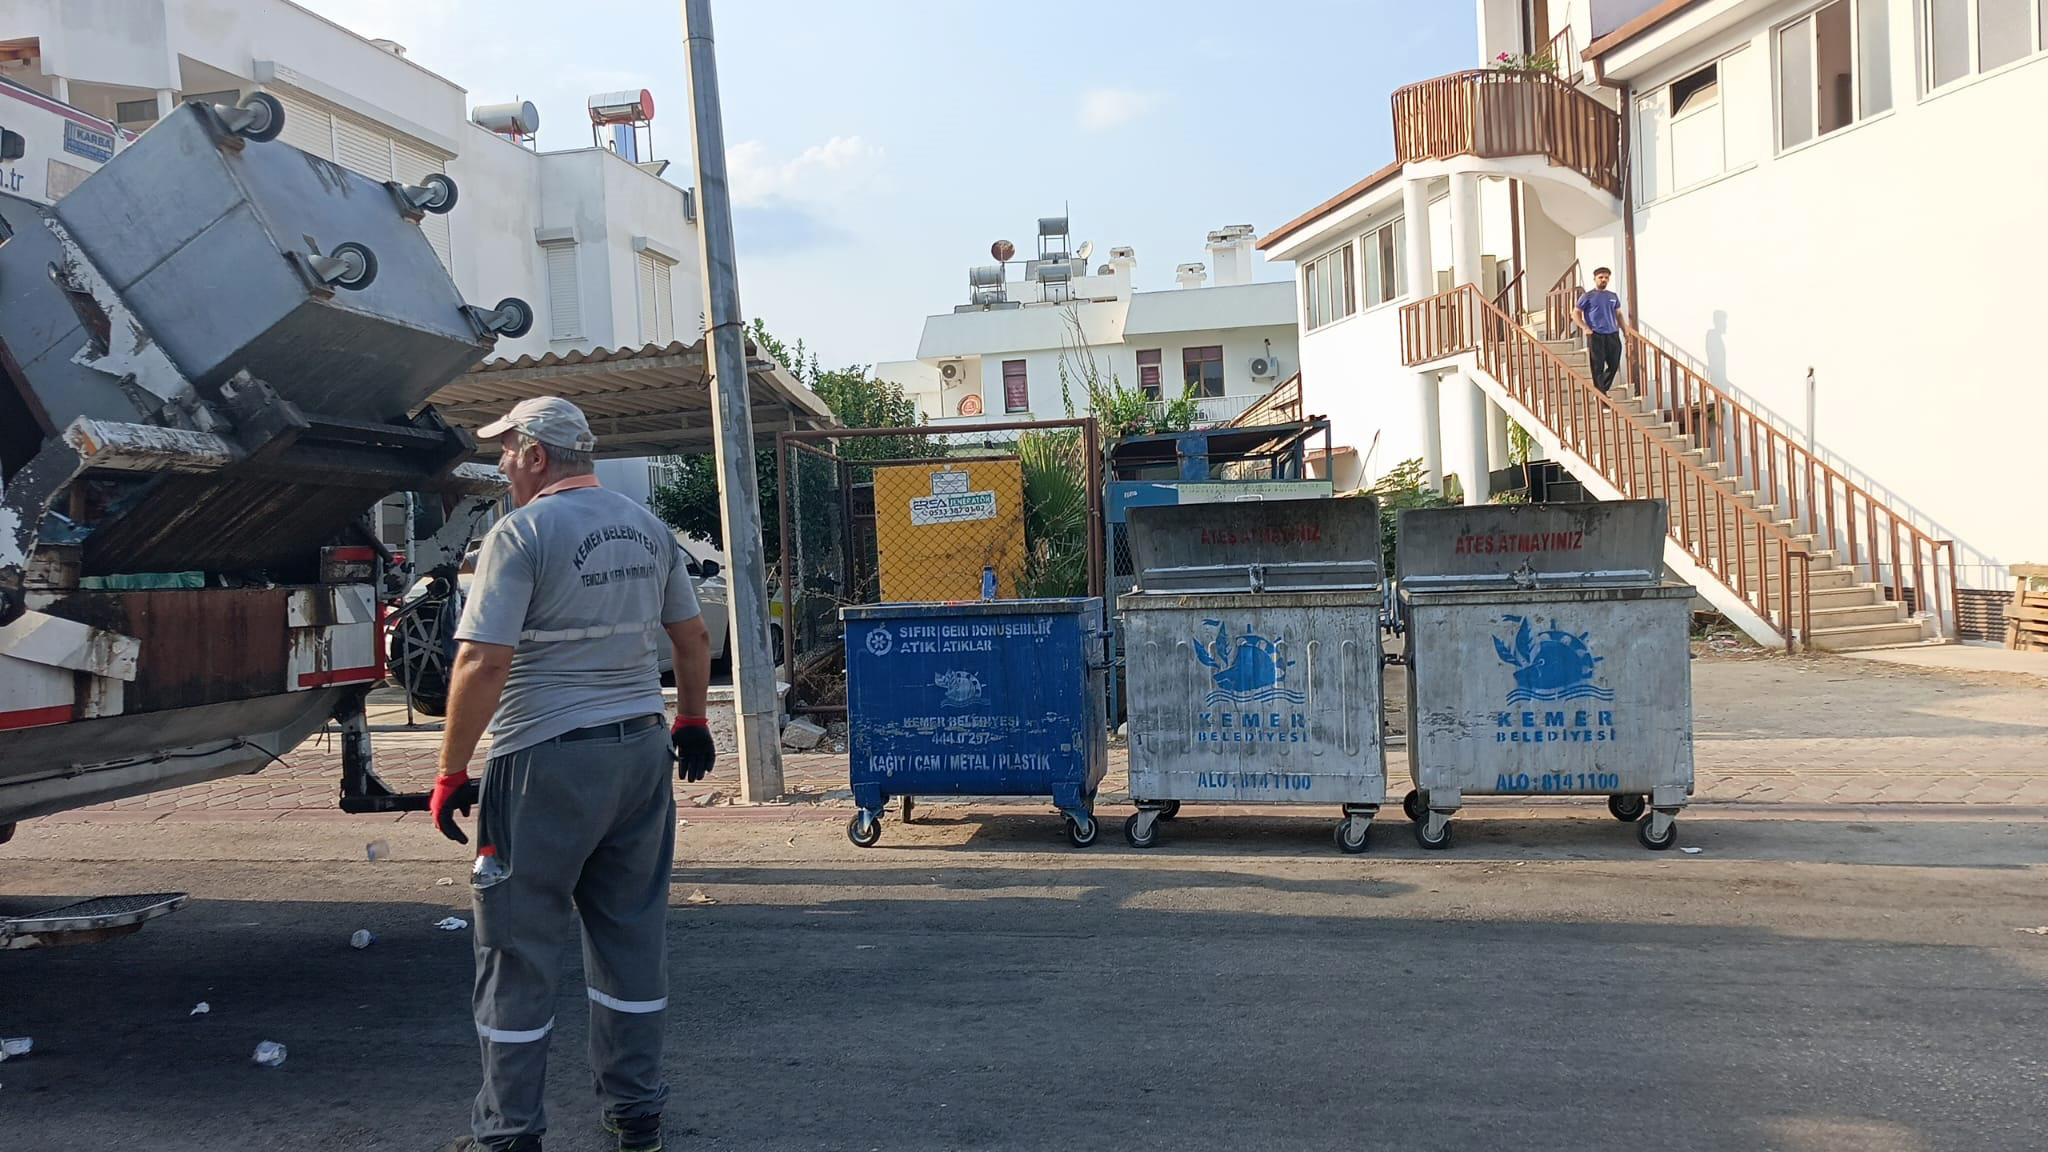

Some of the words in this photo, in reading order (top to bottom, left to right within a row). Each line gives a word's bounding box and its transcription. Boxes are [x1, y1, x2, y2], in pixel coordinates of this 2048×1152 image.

[572, 529, 604, 571] KEMER
[1498, 530, 1583, 553] ATMAYINIZ
[899, 626, 937, 638] SIFIR
[900, 640, 937, 654] ATIK
[942, 639, 992, 652] ATIKLAR
[1198, 711, 1305, 729] KEMER
[1497, 710, 1613, 728] KEMER
[869, 753, 906, 772] KAĞIT
[914, 755, 942, 771] CAM
[950, 754, 990, 771] METAL
